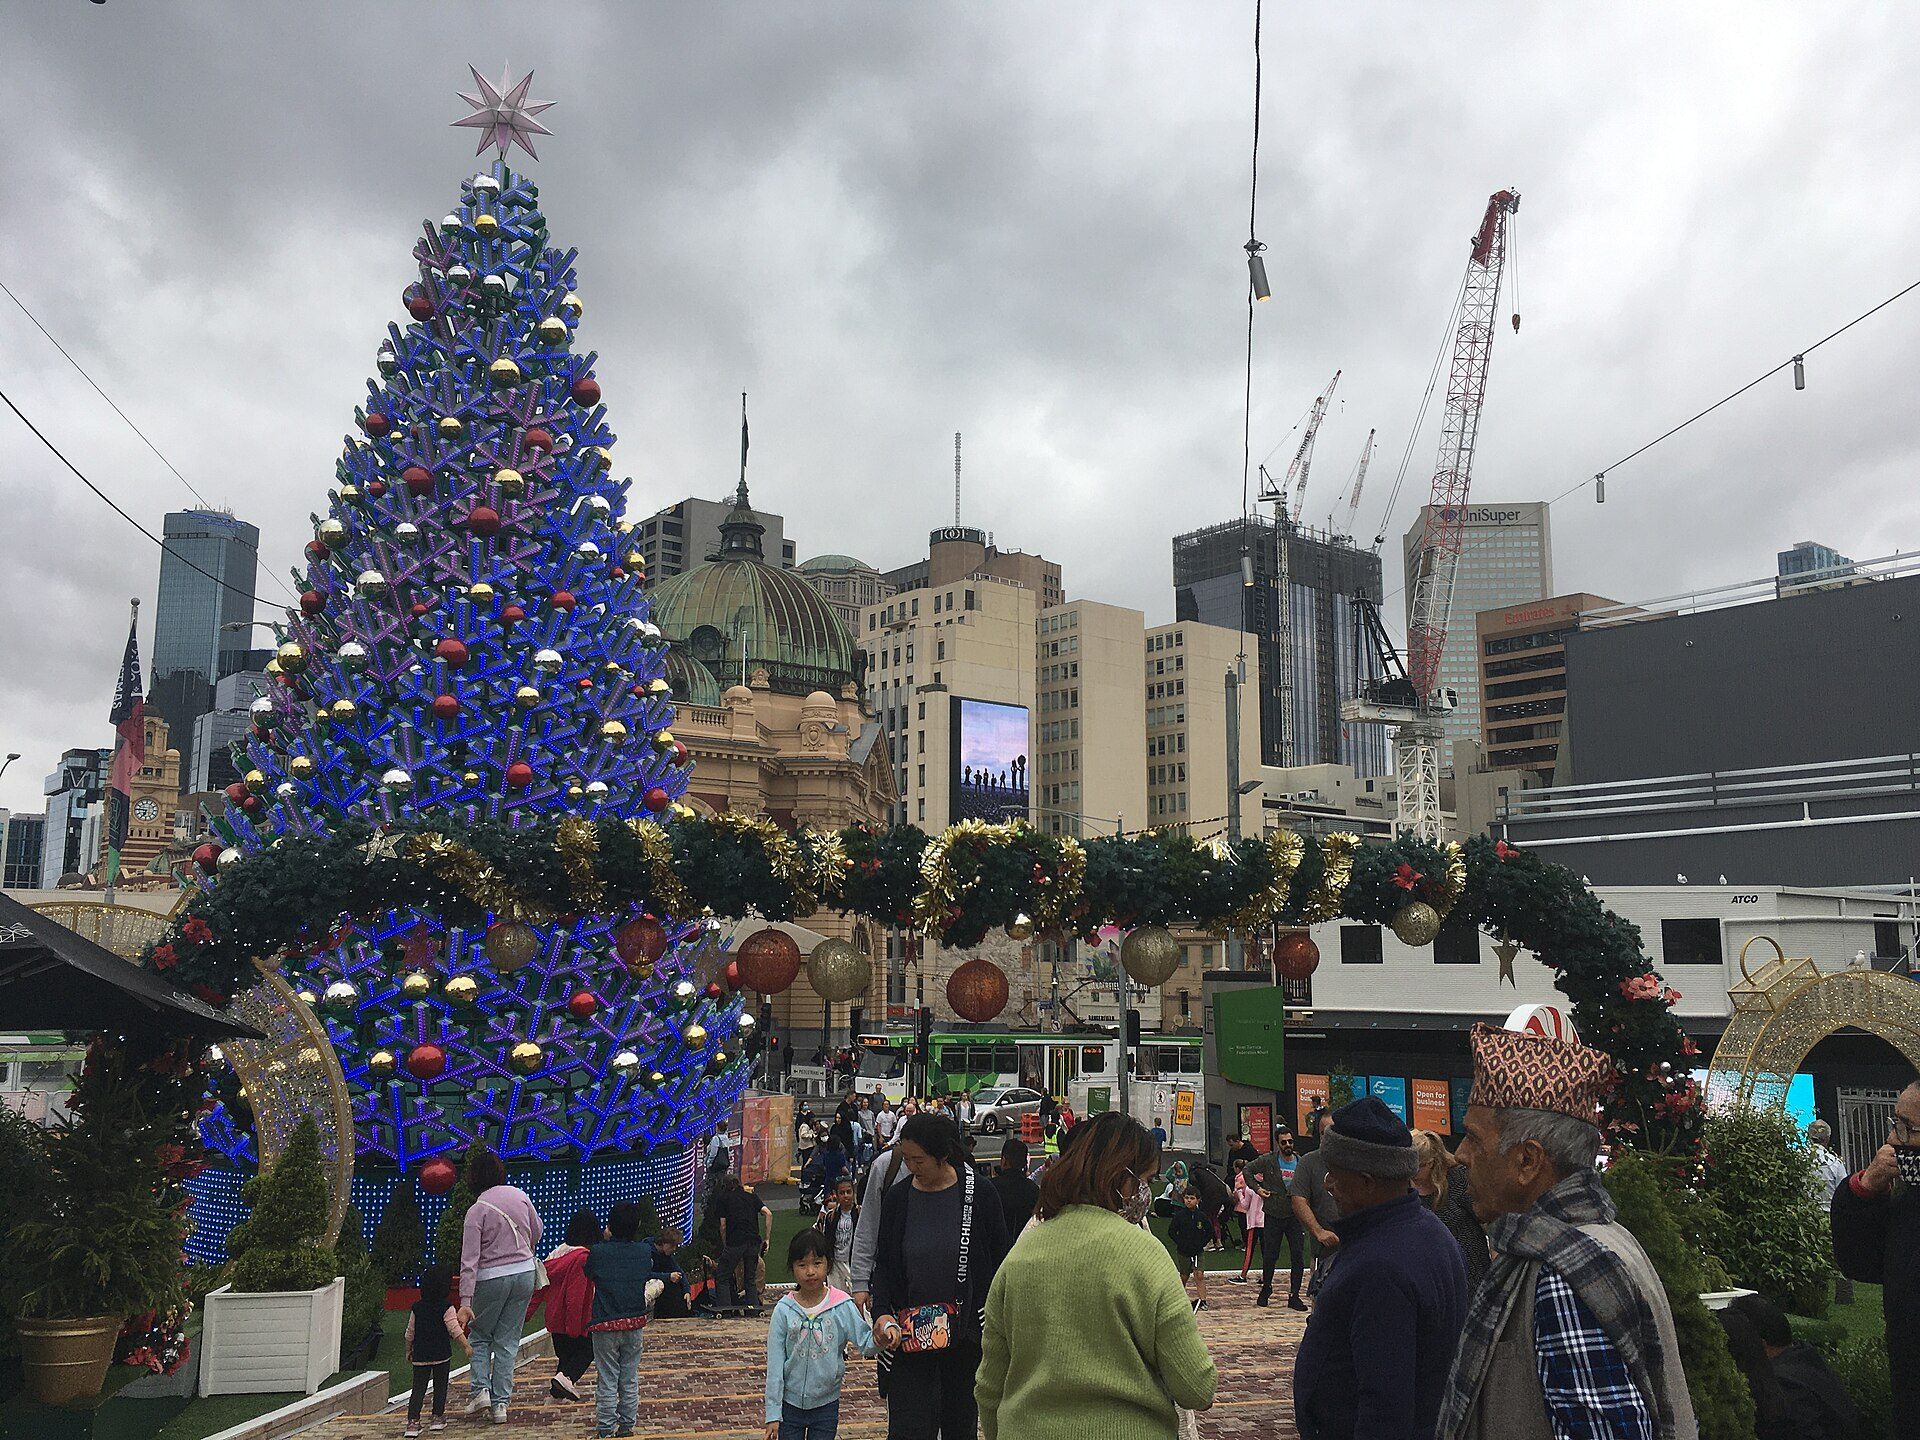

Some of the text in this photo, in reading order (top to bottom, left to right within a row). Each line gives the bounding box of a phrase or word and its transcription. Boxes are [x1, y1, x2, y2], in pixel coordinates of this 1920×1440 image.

[1460, 508, 1521, 524] UniSuper
[1731, 894, 1759, 904] ATCO
[1300, 1087, 1316, 1096] Open
[1416, 1090, 1434, 1100] Open
[1416, 1098, 1446, 1107] business
[1178, 1104, 1192, 1113] CLOSED
[1177, 1113, 1191, 1122] AHEAD
